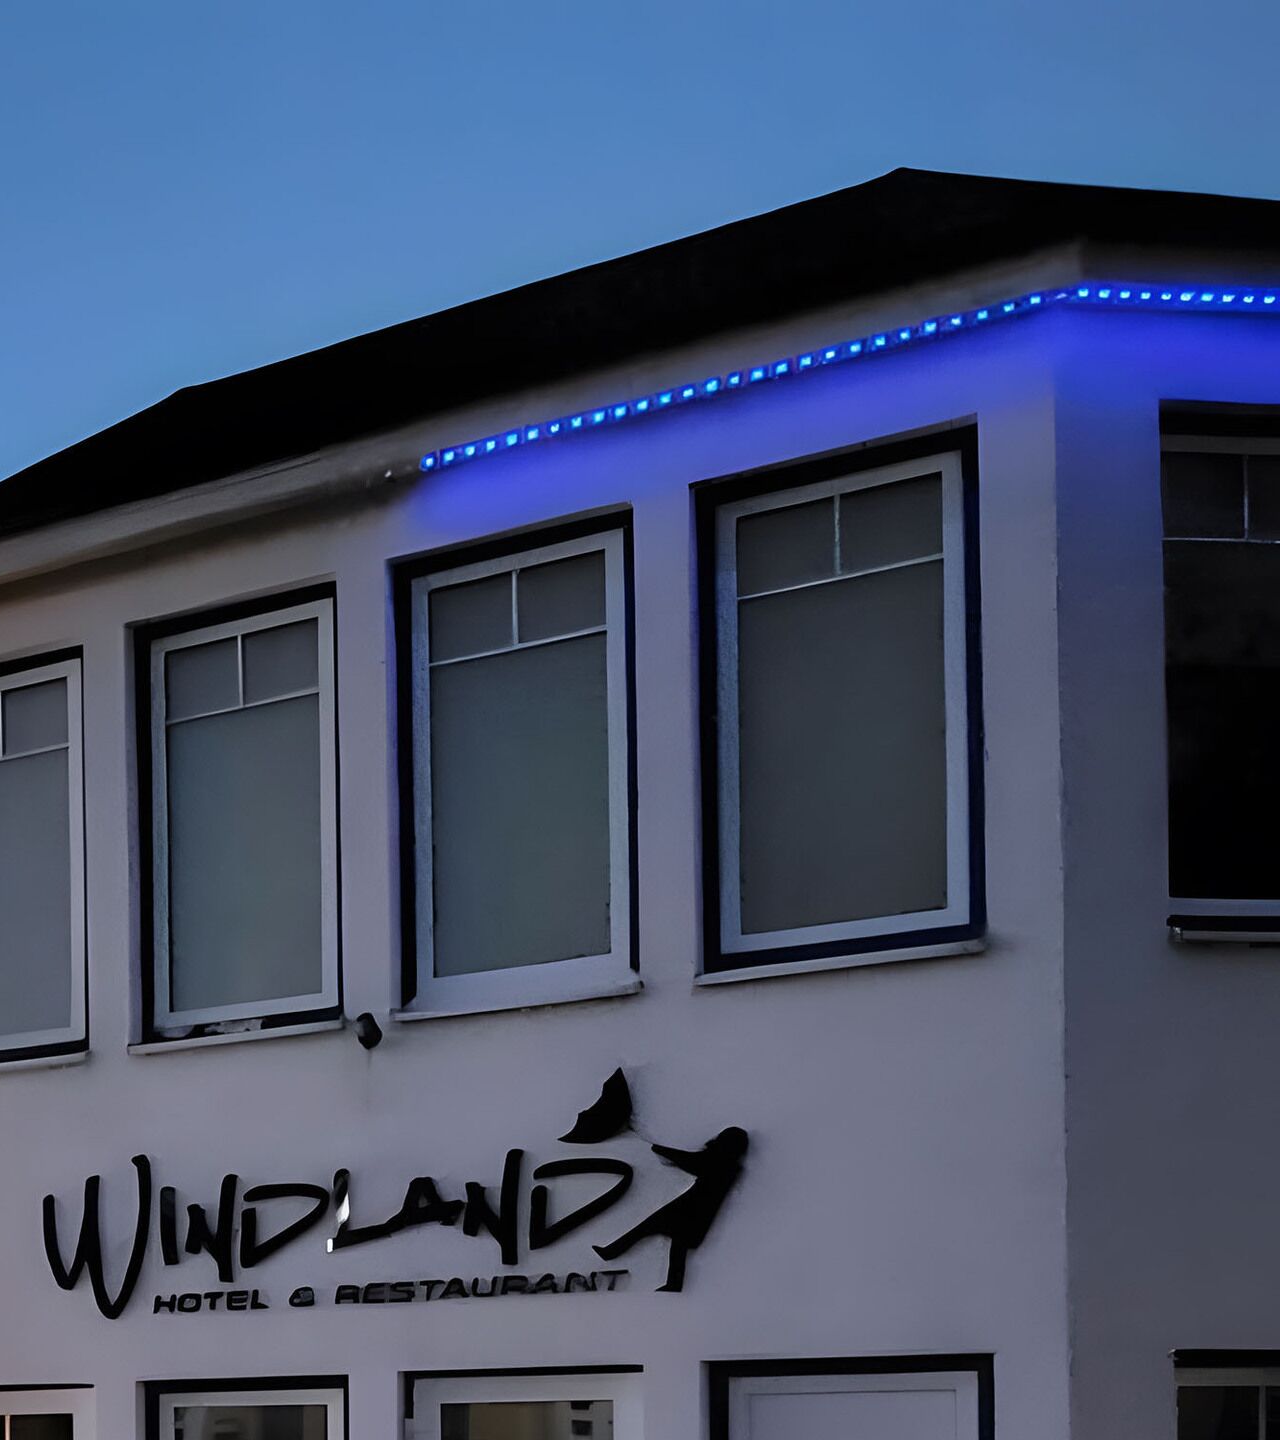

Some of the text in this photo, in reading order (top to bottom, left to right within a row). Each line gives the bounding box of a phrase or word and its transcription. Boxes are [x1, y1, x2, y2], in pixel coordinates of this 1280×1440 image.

[42, 1148, 635, 1320] WINDLAND
[153, 1289, 270, 1314] HOTEL
[335, 1269, 631, 1305] RESTAURANT
